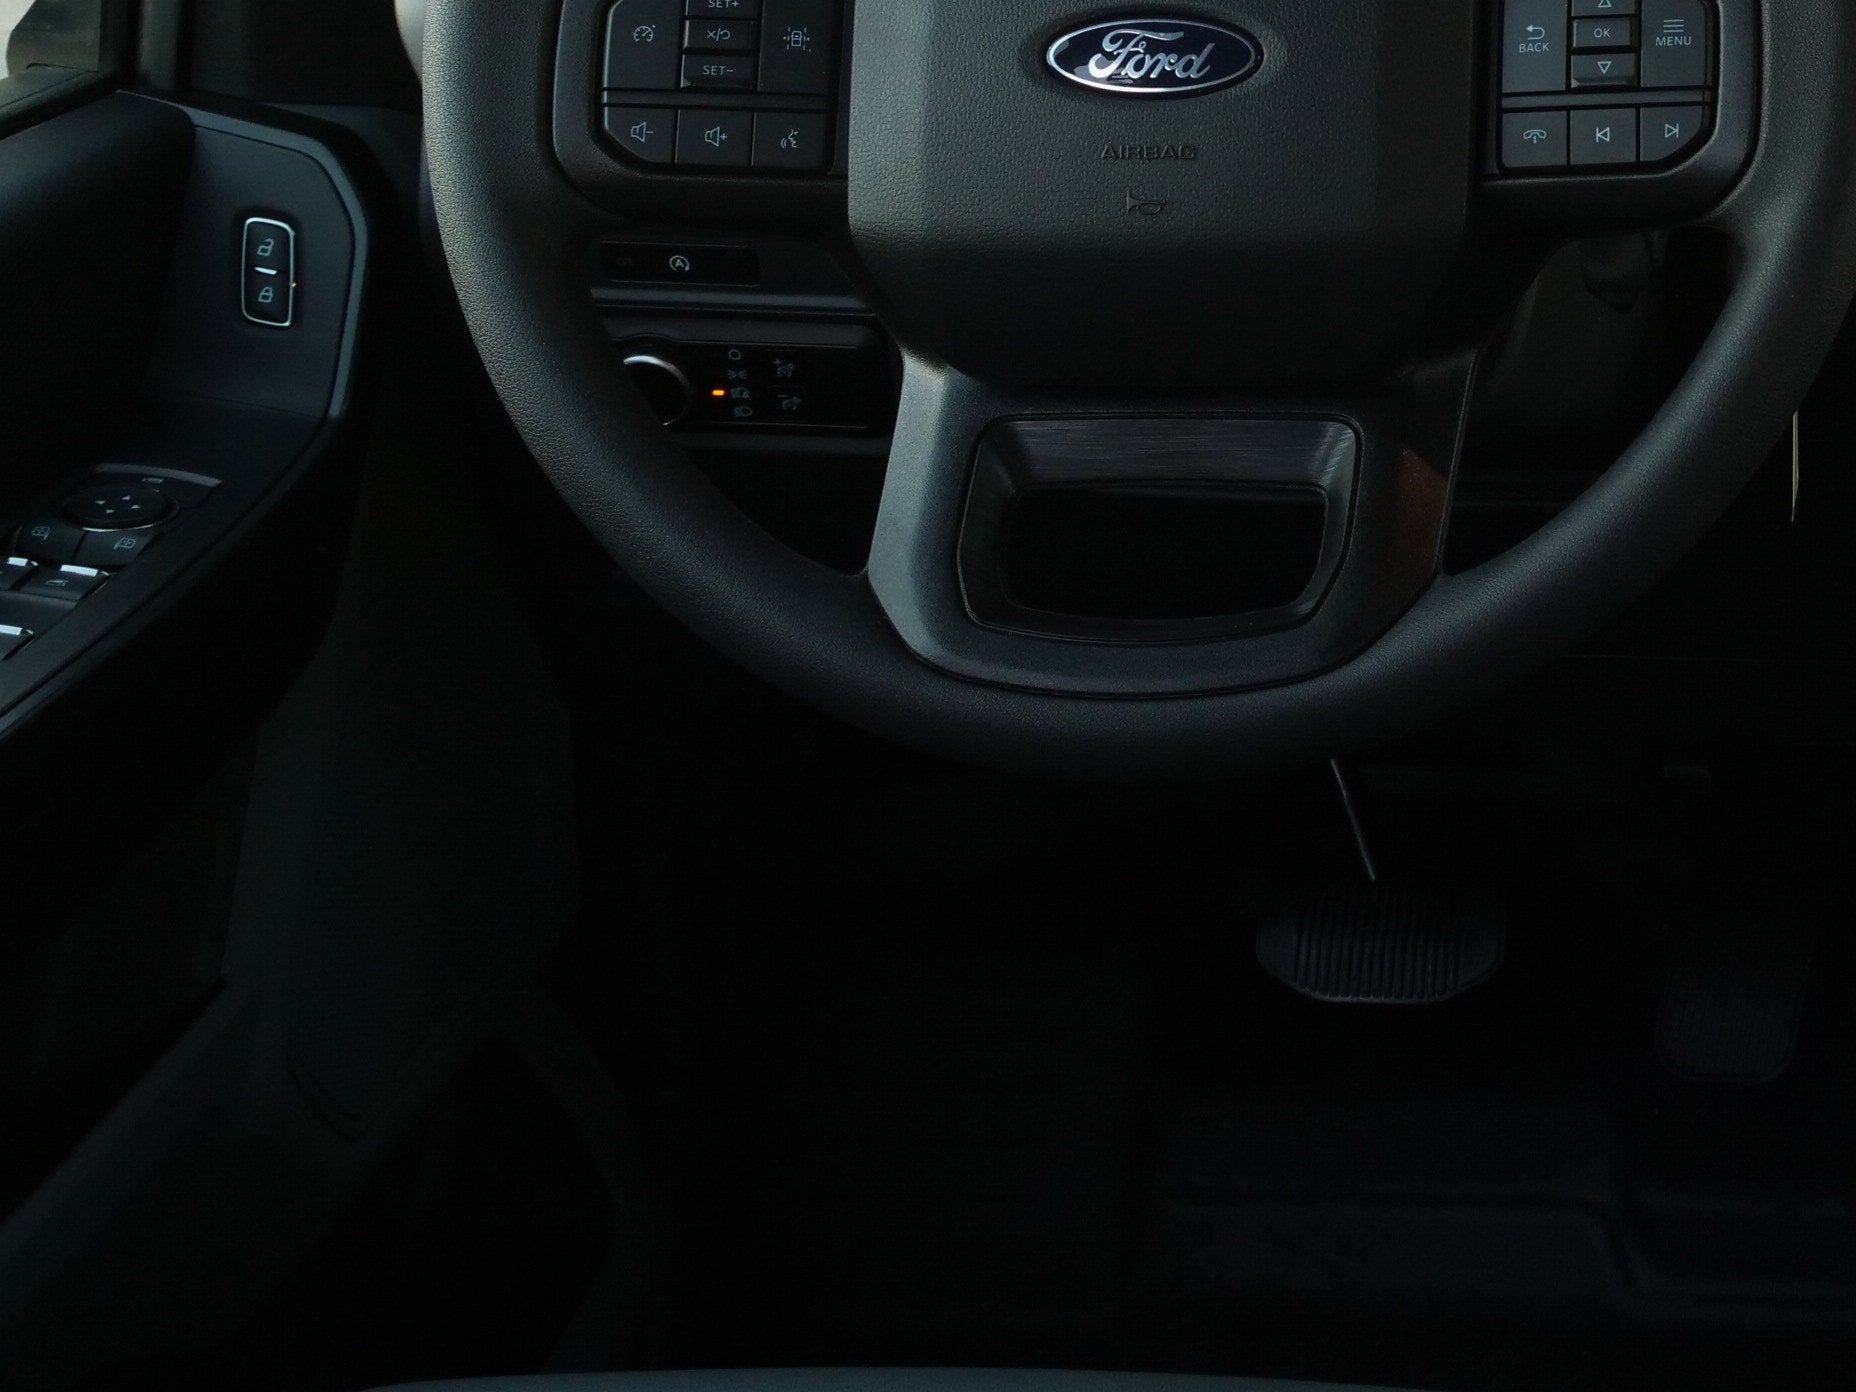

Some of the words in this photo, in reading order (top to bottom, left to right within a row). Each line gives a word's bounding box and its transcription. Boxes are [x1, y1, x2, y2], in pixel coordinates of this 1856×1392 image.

[1594, 27, 1610, 38] OK
[1655, 36, 1692, 47] MENU
[1519, 42, 1549, 53] BACK
[1088, 28, 1215, 79] Ford
[1100, 144, 1197, 159] AIRBAG
